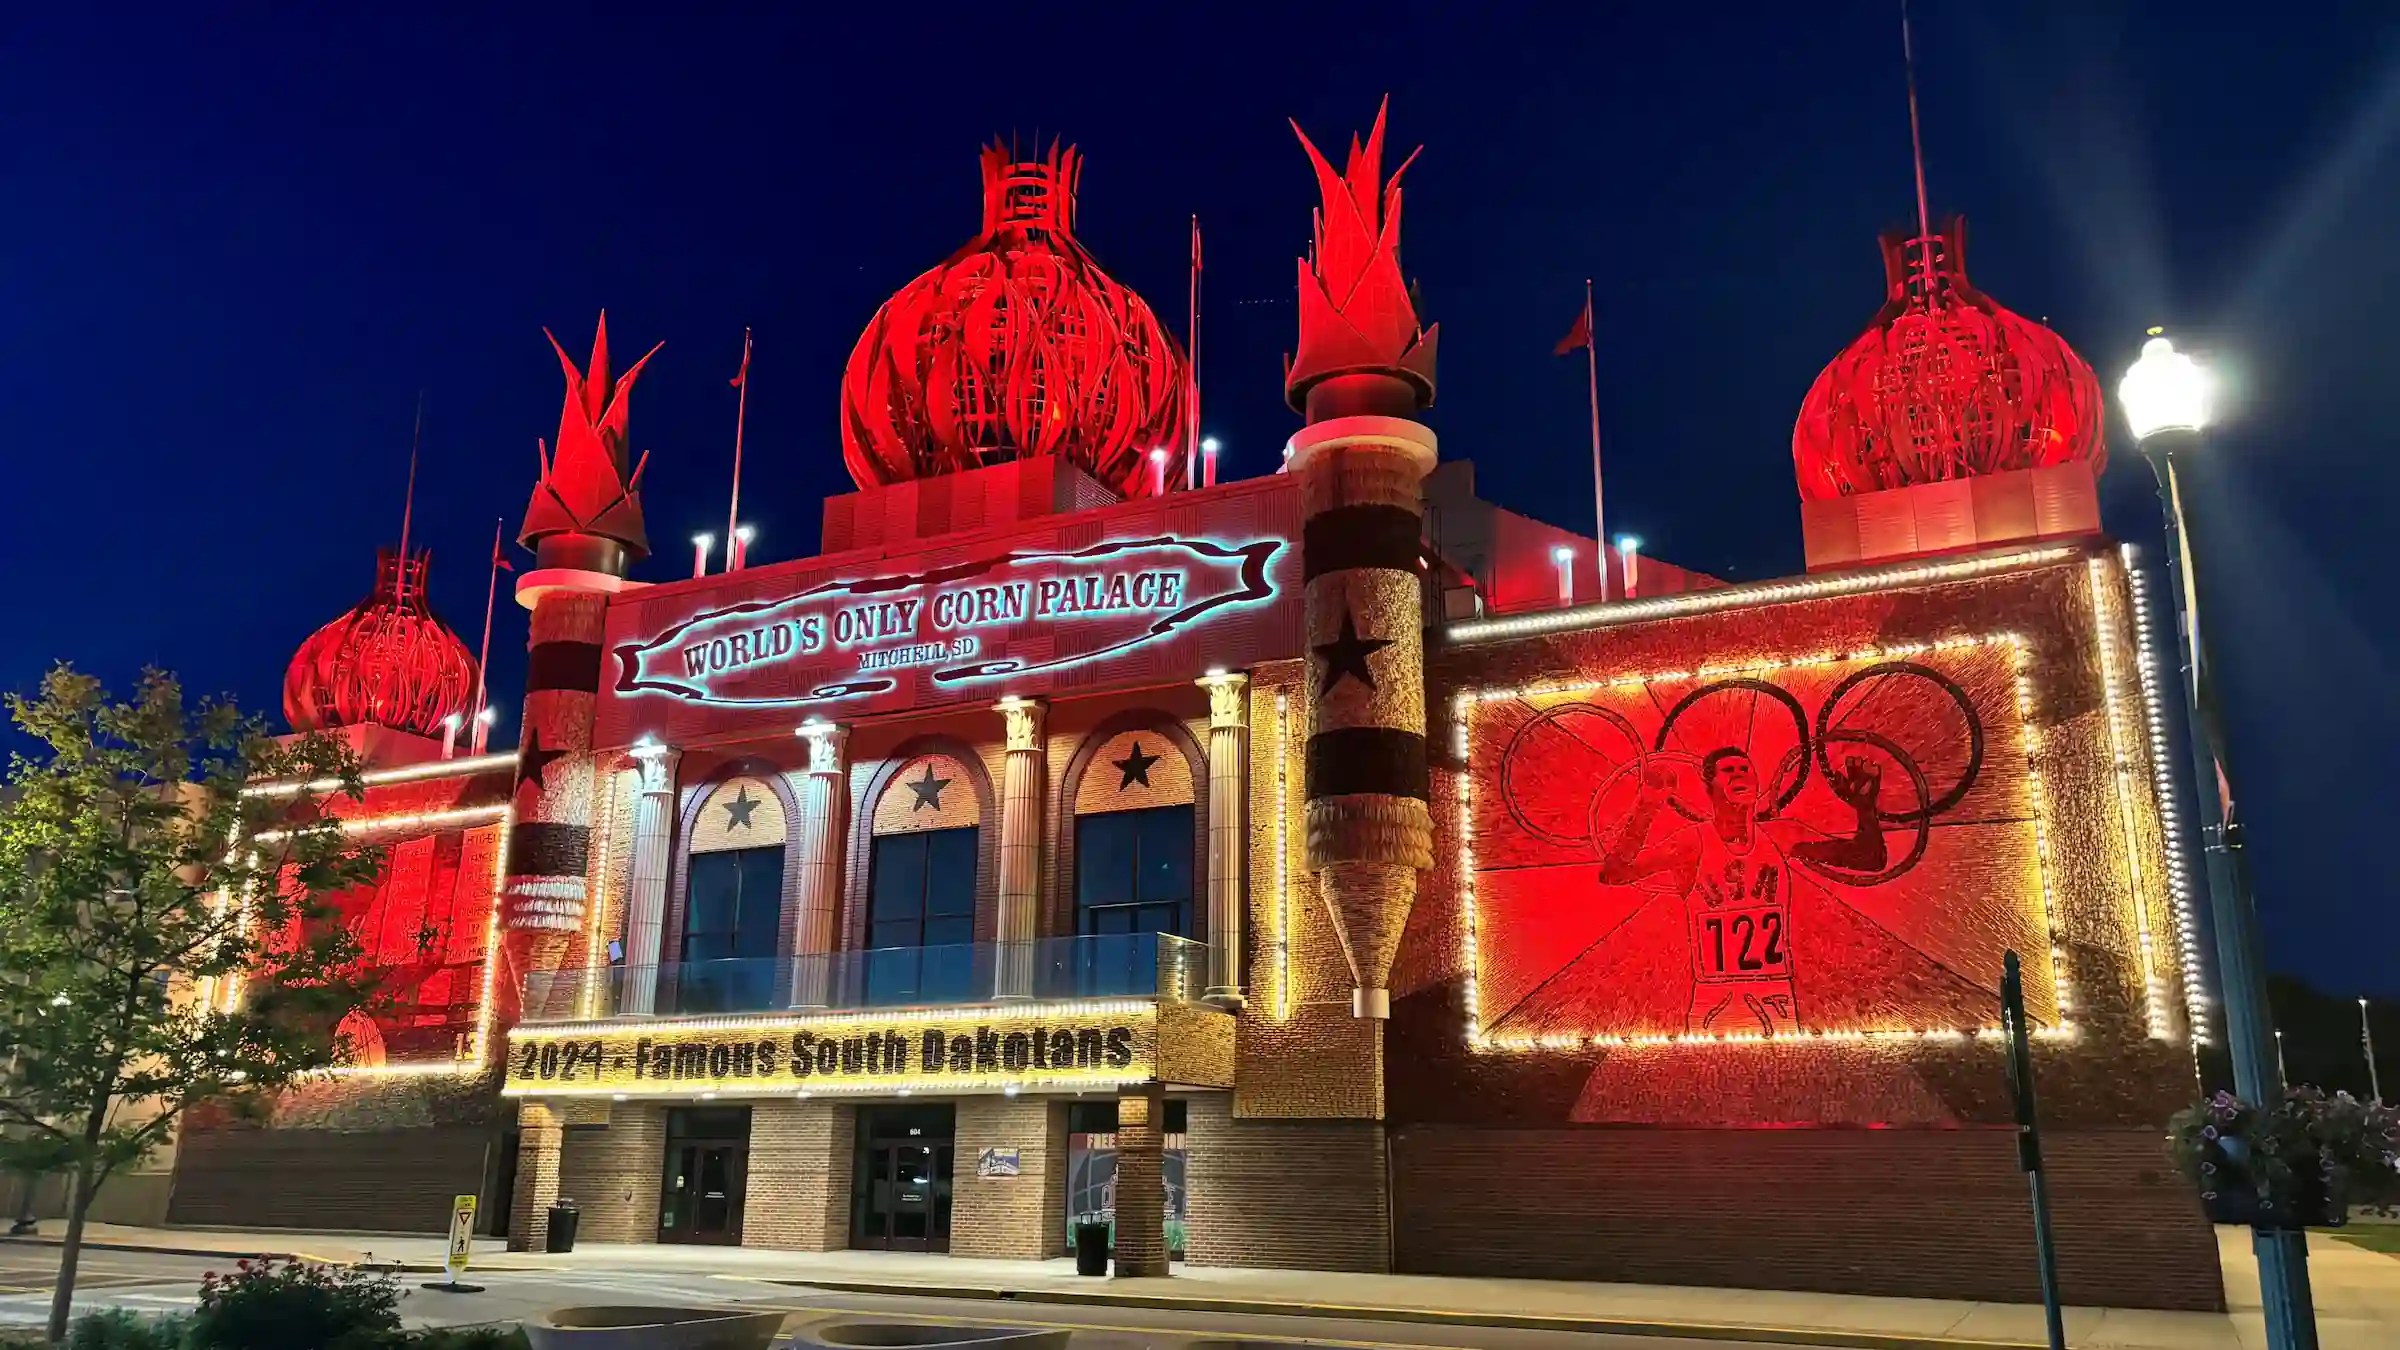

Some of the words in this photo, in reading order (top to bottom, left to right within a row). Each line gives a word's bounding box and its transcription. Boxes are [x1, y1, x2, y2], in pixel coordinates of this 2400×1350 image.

[684, 617, 821, 678] WORLD'S
[834, 599, 918, 644] ONLY
[933, 584, 1026, 628] CORN
[1038, 572, 1181, 615] PALACE
[1695, 859, 1779, 909] USA
[520, 1040, 603, 1081] 2024
[635, 1036, 777, 1082] Famous
[791, 1028, 908, 1078] South
[922, 1024, 1133, 1075] Dakotans
